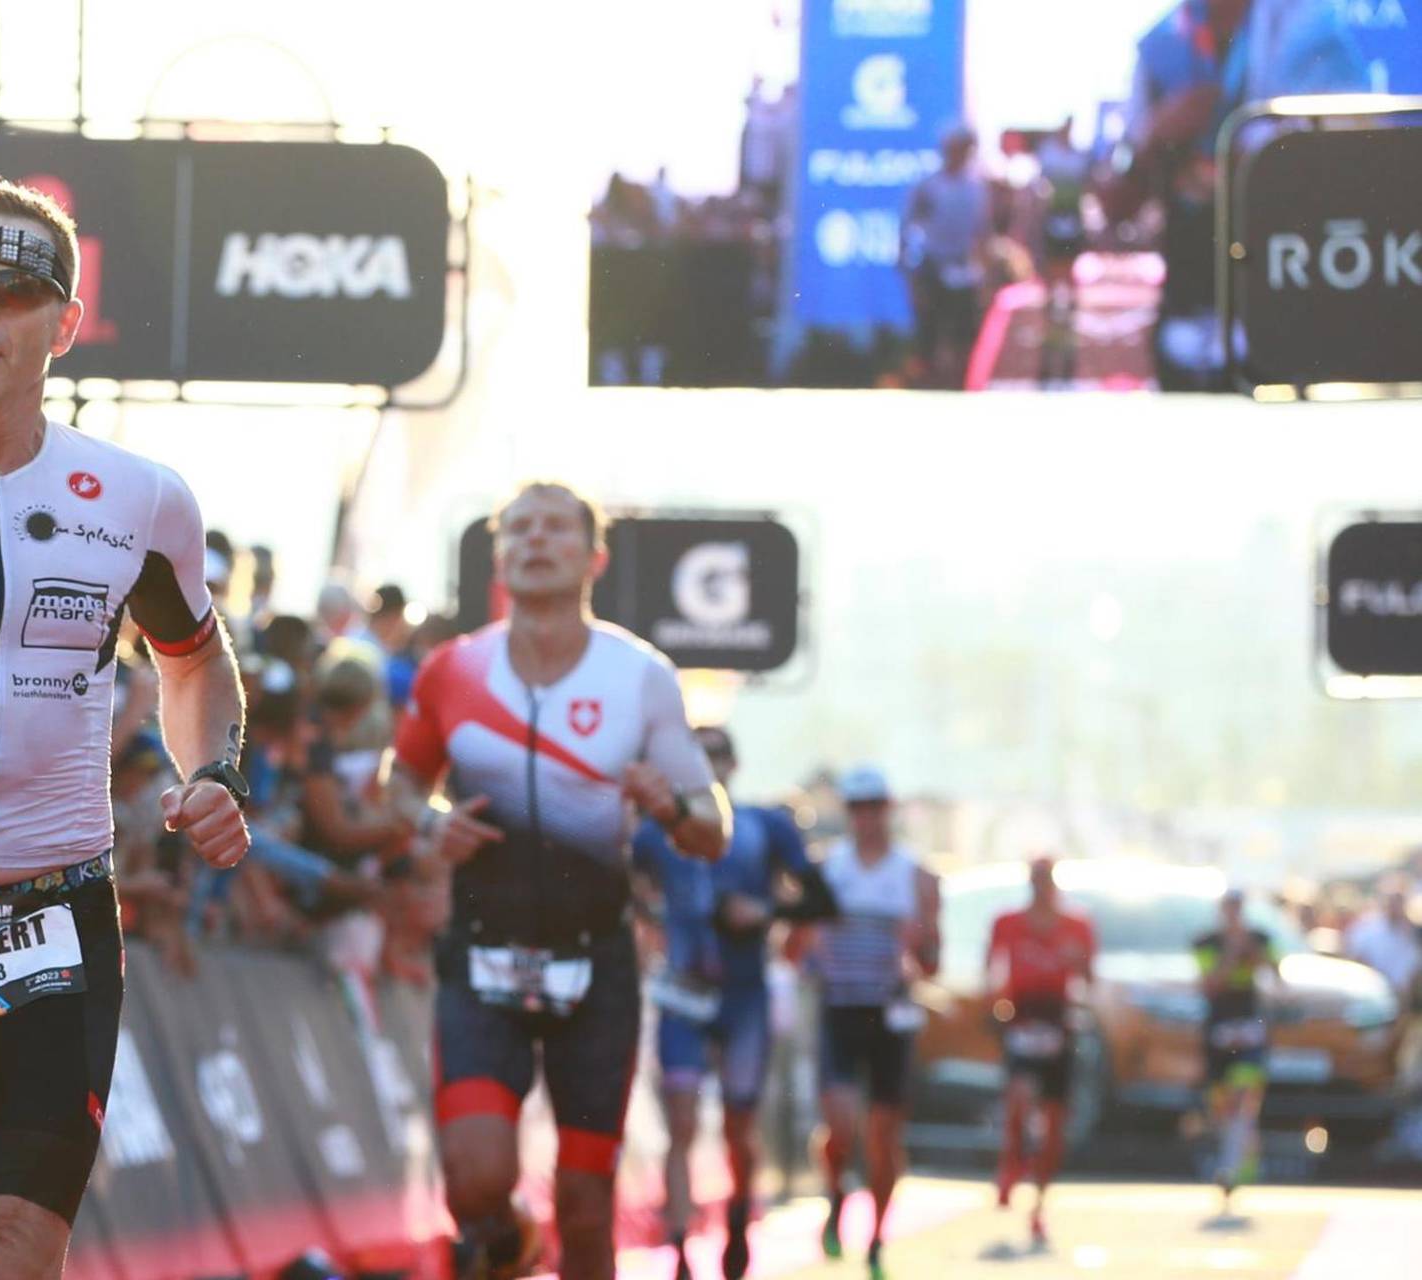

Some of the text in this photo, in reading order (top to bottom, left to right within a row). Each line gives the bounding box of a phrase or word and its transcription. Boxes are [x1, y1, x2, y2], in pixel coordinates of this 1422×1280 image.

[215, 232, 412, 299] HOKA
[35, 594, 105, 610] monte
[32, 607, 95, 622] mare
[12, 673, 70, 692] bronny
